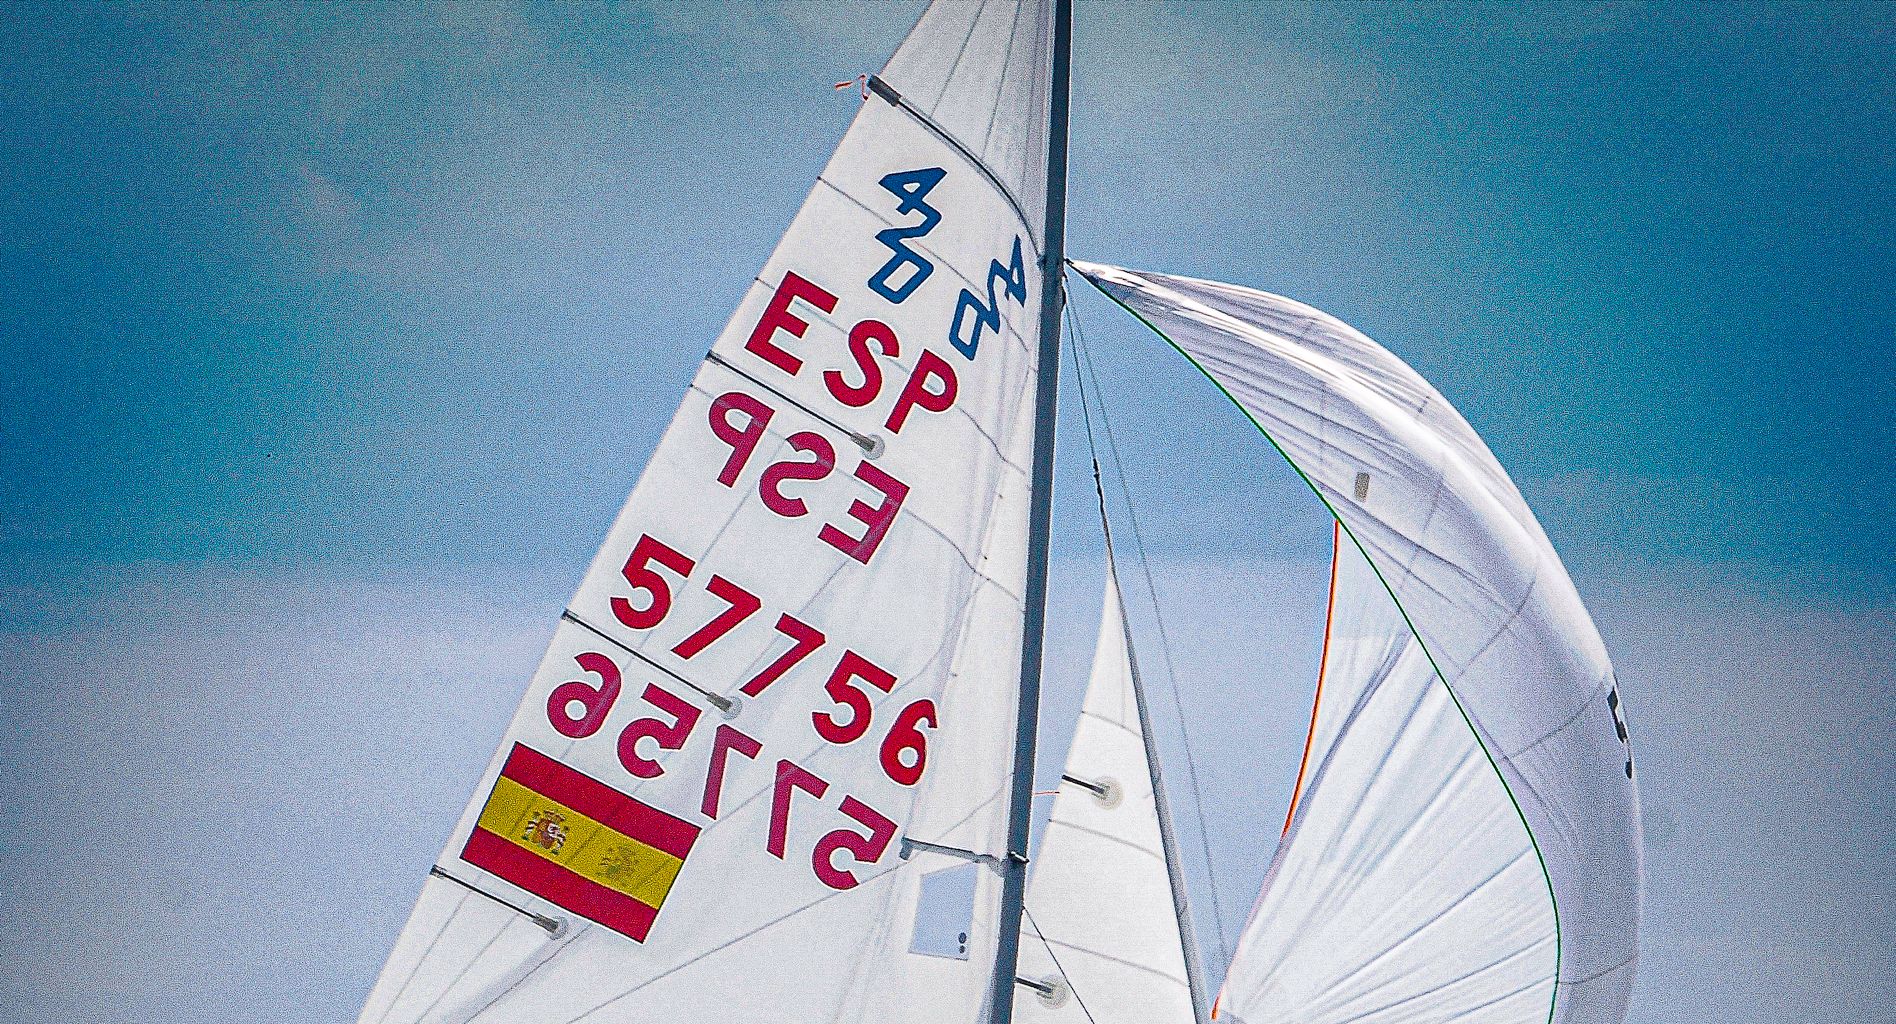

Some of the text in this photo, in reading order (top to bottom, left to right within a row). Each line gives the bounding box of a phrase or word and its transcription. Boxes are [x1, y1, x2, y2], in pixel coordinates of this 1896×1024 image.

[867, 167, 948, 304] 420
[744, 270, 958, 434] ESP
[610, 533, 938, 786] 57756
